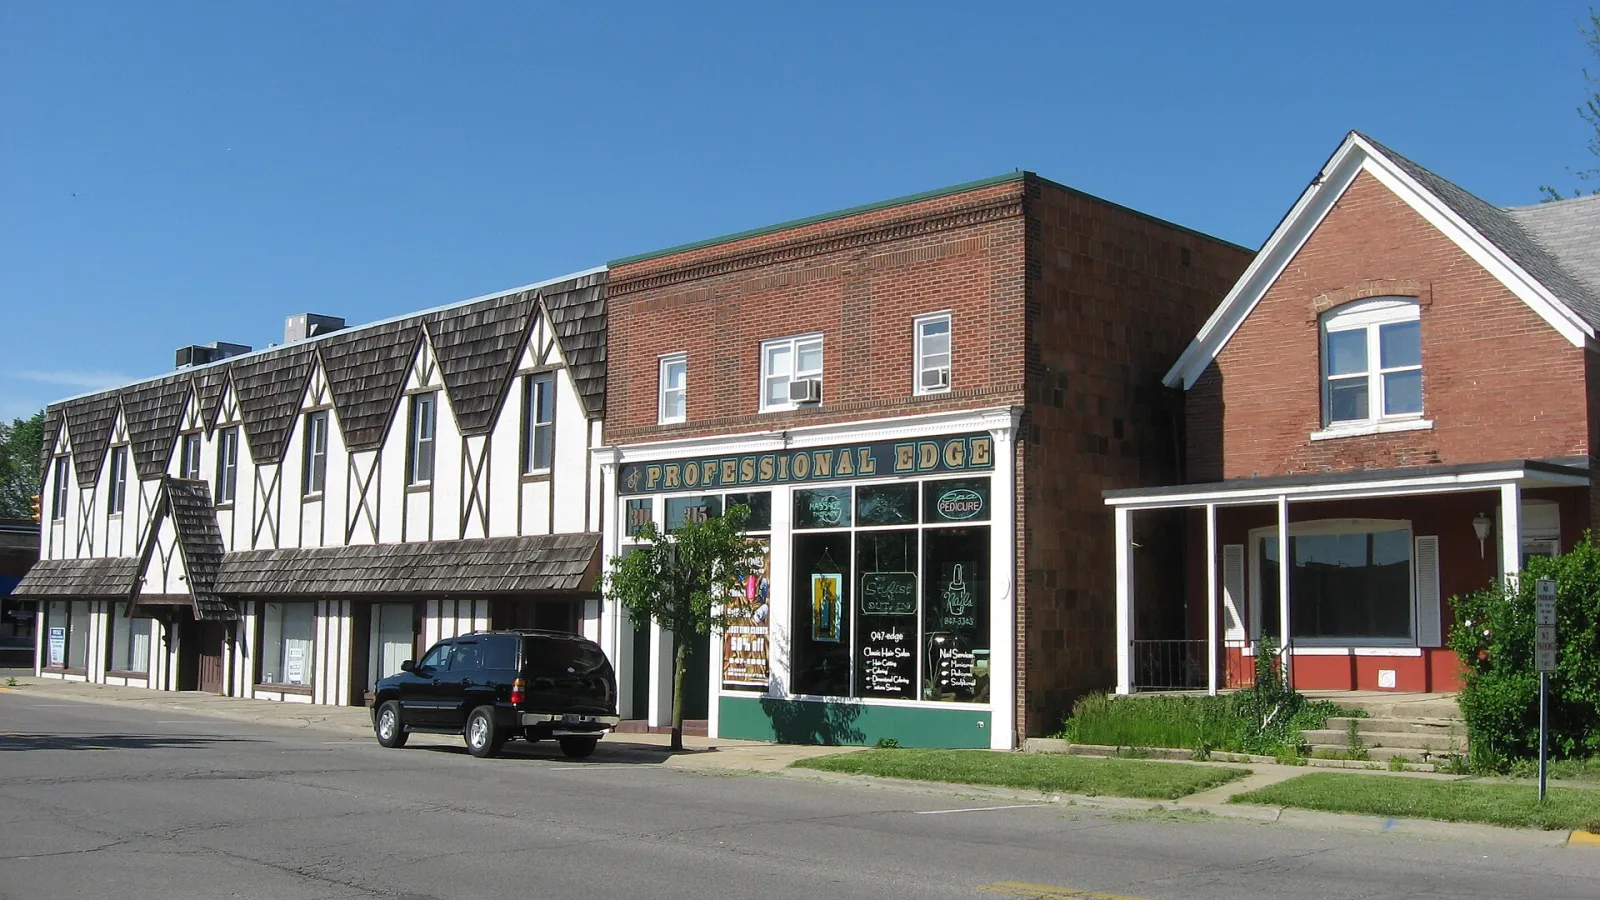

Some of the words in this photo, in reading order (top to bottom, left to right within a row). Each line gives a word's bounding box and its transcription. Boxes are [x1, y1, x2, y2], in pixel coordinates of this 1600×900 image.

[645, 447, 877, 491] PROFESSIONAL
[893, 435, 992, 473] EDGE
[941, 491, 978, 502] Spa
[808, 501, 841, 511] MASSAGE
[939, 501, 980, 512] PEDICURE
[683, 505, 708, 524] 315
[864, 580, 912, 598] Stylist
[943, 591, 973, 612] Nails
[1541, 631, 1550, 640] NO
[730, 636, 751, 652] 50%
[752, 637, 765, 652] off
[881, 647, 895, 657] Hair
[894, 647, 911, 658] Salon
[939, 648, 951, 659] Nail
